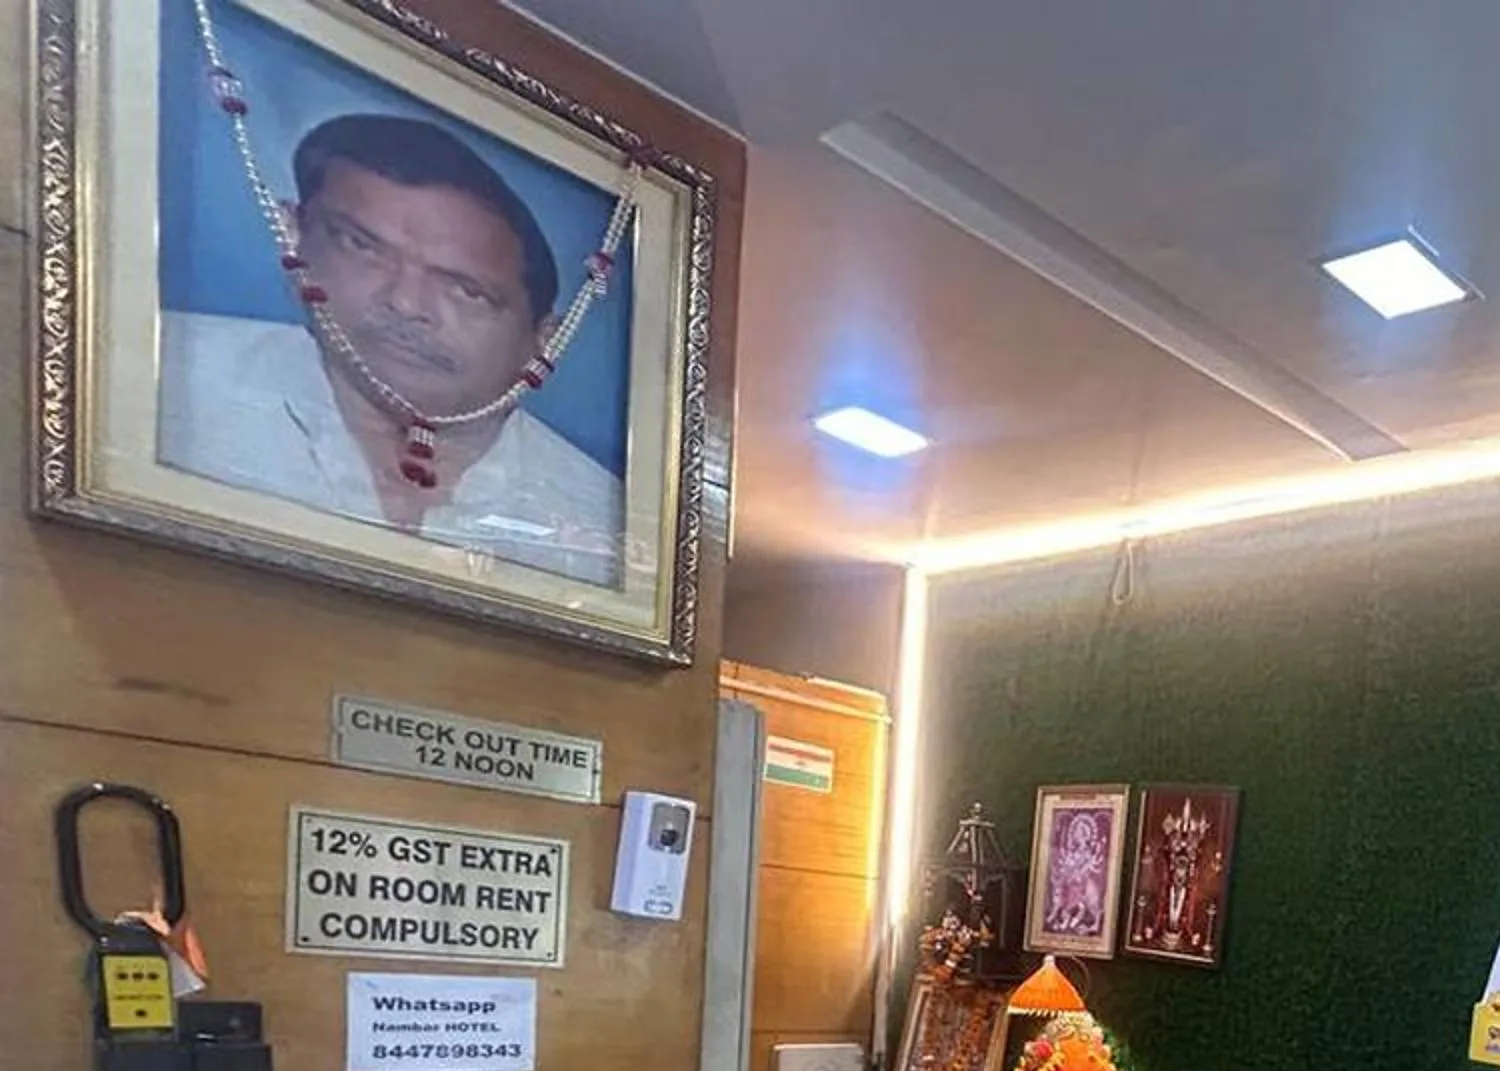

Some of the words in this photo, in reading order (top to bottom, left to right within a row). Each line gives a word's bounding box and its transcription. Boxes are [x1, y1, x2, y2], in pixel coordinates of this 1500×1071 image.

[351, 709, 456, 746] CHECK
[463, 730, 523, 757] OUT
[528, 740, 589, 769] TIME
[415, 746, 446, 767] 12
[454, 750, 535, 781] NOON
[311, 828, 377, 858] 12%
[388, 836, 451, 866] GST
[461, 845, 553, 878] EXTRA
[307, 869, 358, 897] ON
[369, 875, 466, 907] ROOM
[475, 885, 552, 914] RENT
[319, 912, 539, 950] COMPULSORY
[372, 996, 497, 1014] Whatsapp
[444, 1022, 502, 1033] HOTEL
